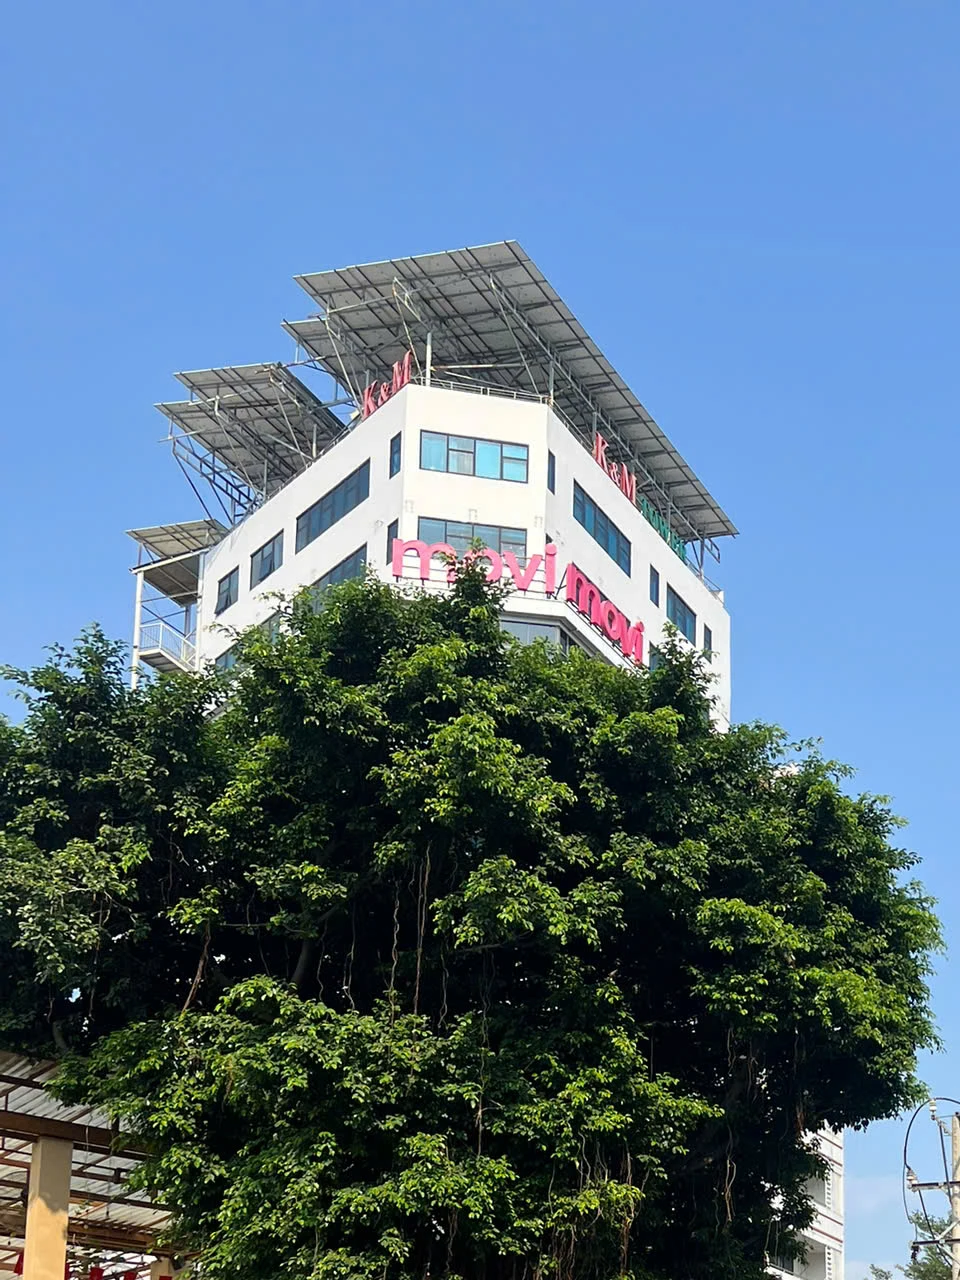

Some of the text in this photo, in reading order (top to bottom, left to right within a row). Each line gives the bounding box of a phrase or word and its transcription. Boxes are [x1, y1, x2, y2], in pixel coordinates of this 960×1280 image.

[362, 350, 411, 420] K&M
[593, 431, 637, 506] K&M
[565, 561, 645, 665] movi
